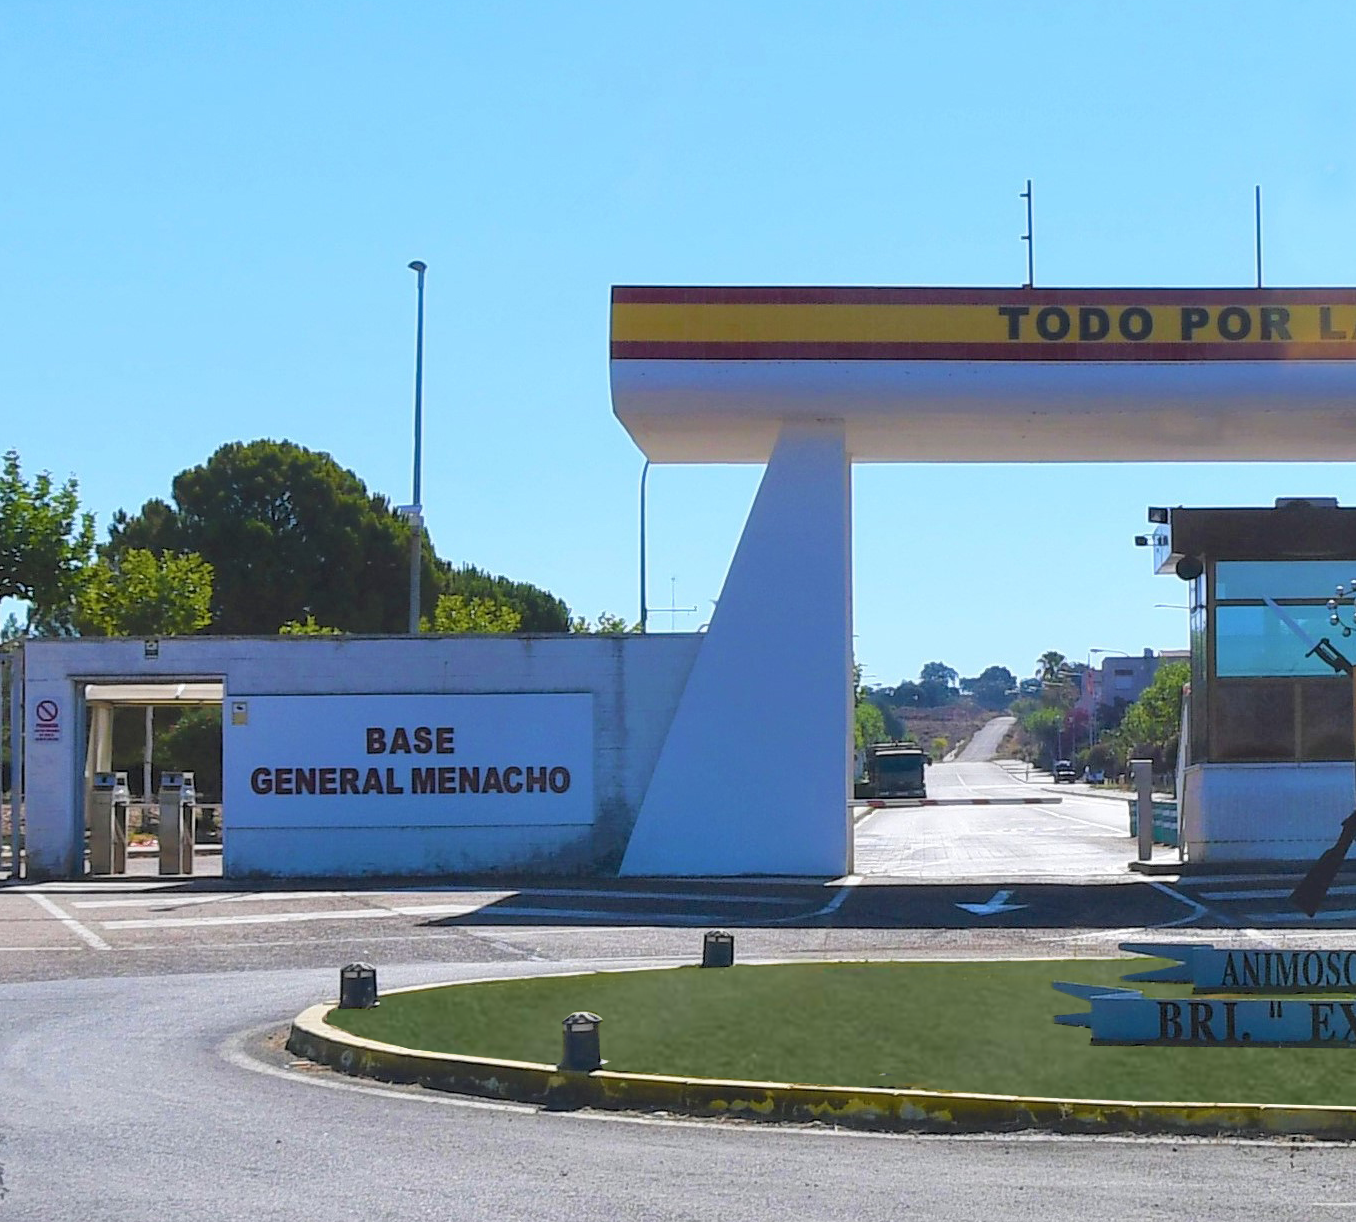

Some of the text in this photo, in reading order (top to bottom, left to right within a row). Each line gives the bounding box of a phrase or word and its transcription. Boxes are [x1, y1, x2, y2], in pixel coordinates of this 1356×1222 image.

[1000, 305, 1154, 341] TODO
[1181, 305, 1294, 341] POR
[366, 727, 455, 754] BASE
[250, 766, 571, 795] GENERAL MENACHO
[1156, 1000, 1250, 1042] BRI.
